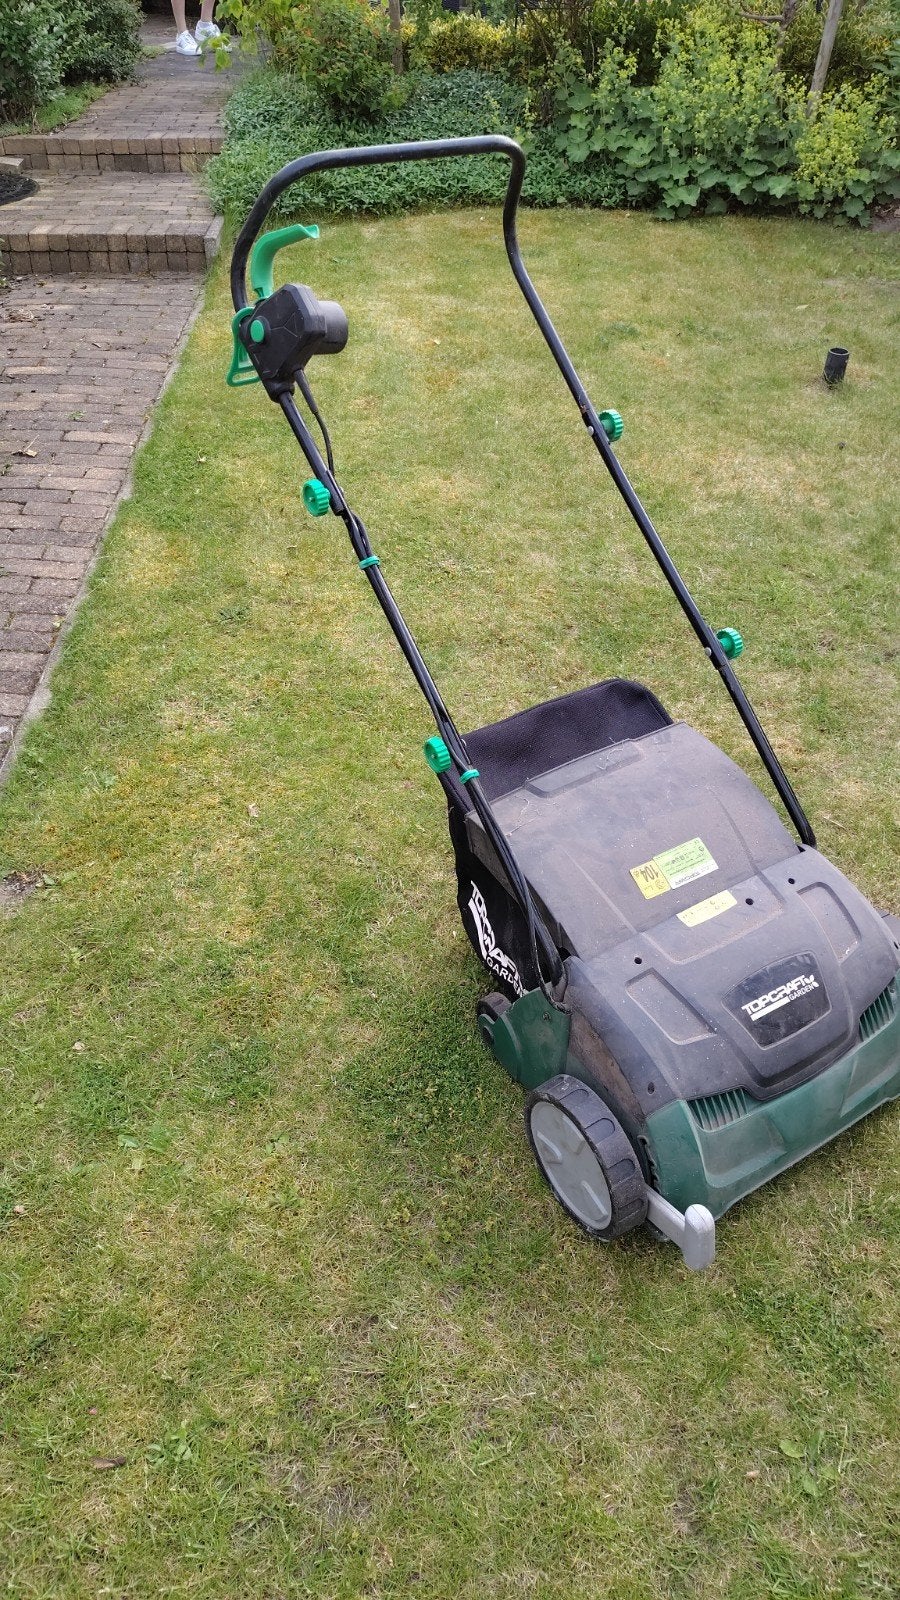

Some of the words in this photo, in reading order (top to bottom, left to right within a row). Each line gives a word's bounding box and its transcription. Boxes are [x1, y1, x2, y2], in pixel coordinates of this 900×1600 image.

[639, 865, 659, 882] 104
[486, 957, 524, 997] GARDEN
[741, 974, 806, 1015] TOPCRAFT
[788, 984, 815, 1001] GARDEN
